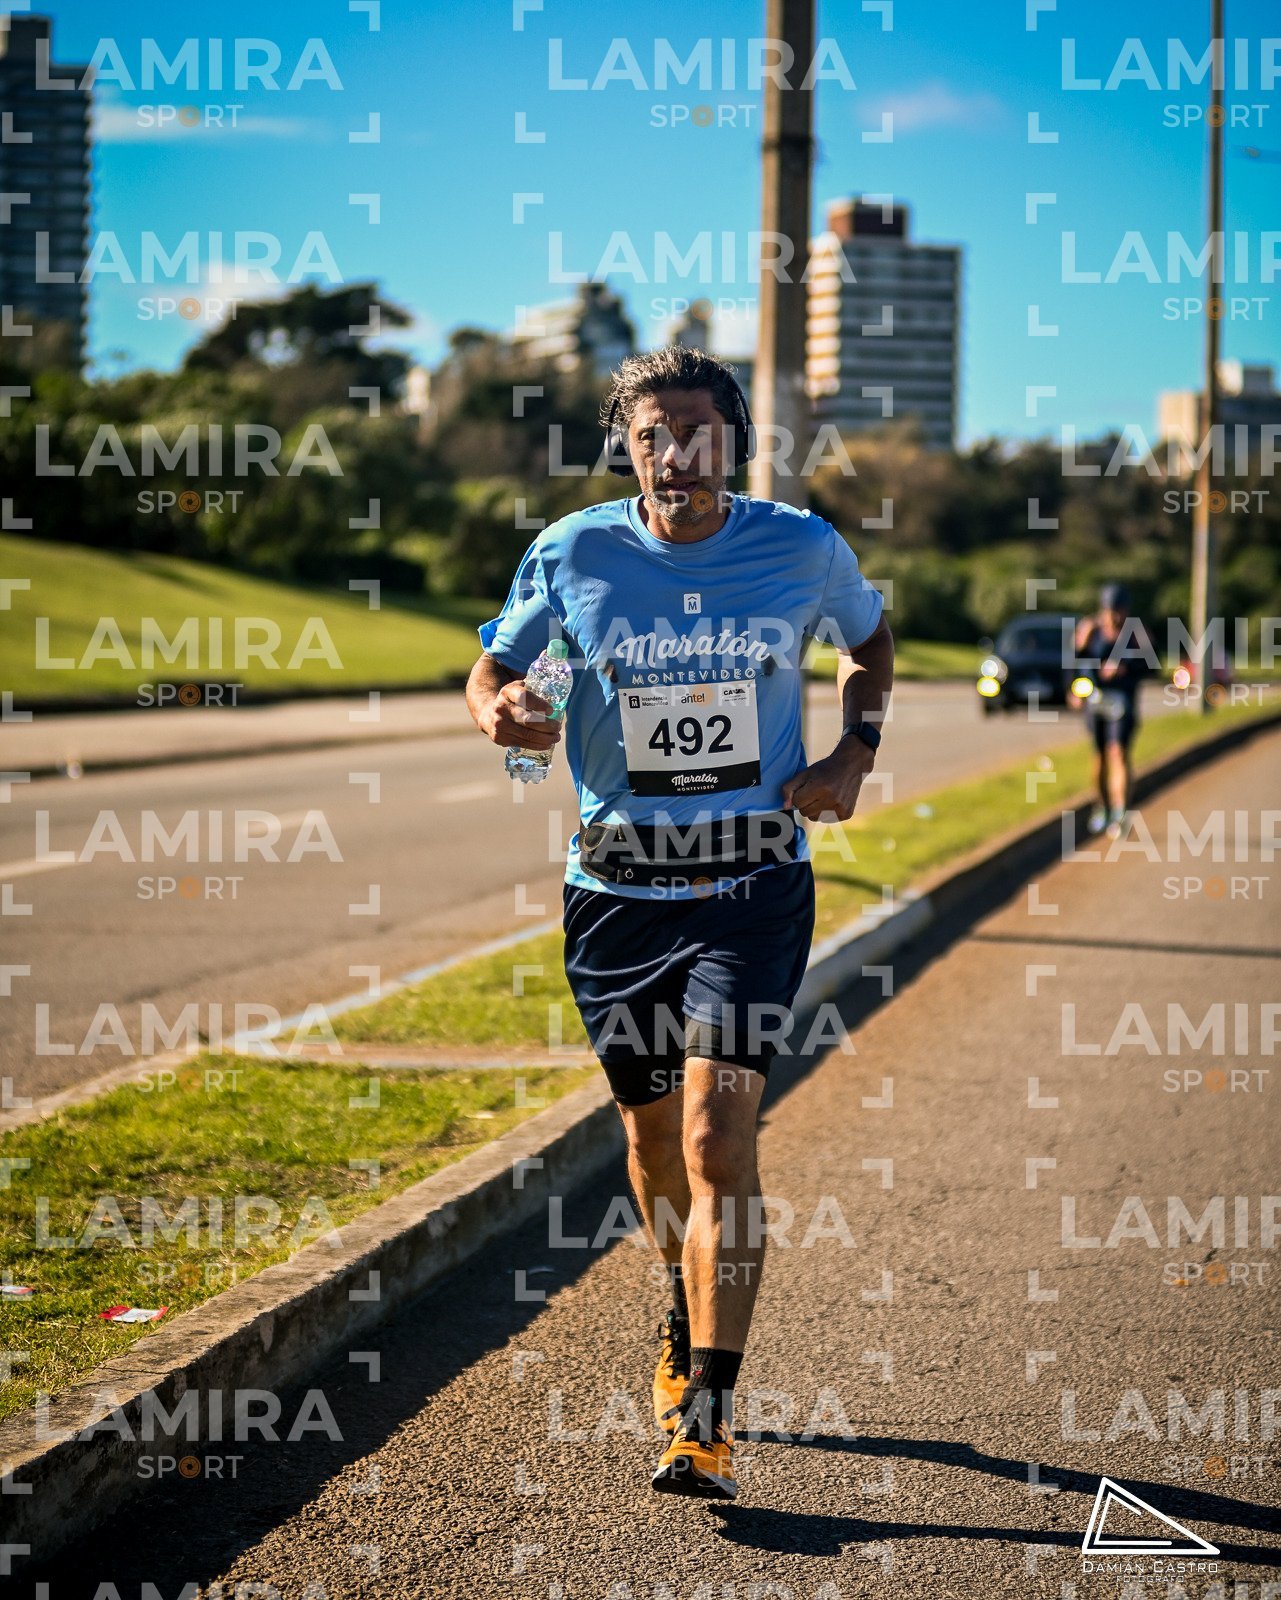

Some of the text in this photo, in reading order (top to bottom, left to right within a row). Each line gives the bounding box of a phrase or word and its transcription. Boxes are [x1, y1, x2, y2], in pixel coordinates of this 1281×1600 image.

[615, 629, 770, 668] Maratón
[632, 667, 756, 685] MONTEVIDEO
[681, 692, 705, 704] antel
[648, 714, 734, 757] 492
[671, 773, 719, 786] Maratón
[677, 784, 715, 792] MONTEVIDEO
